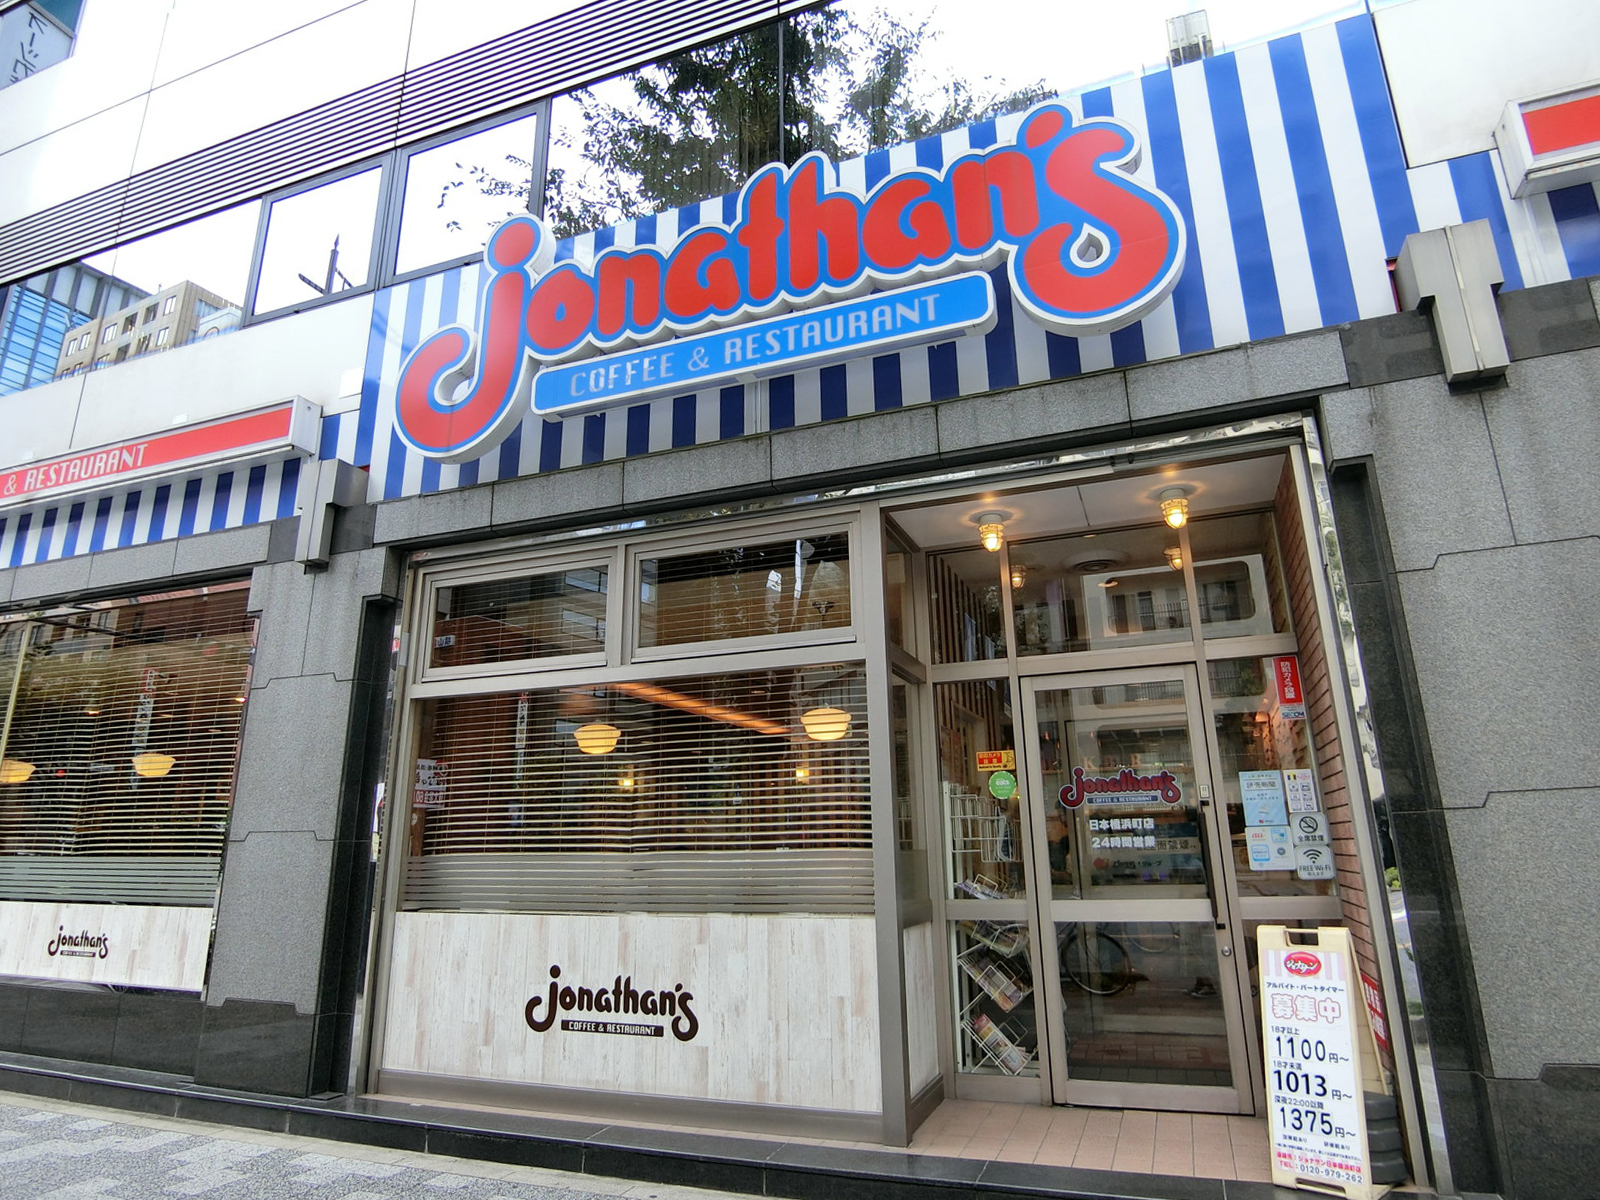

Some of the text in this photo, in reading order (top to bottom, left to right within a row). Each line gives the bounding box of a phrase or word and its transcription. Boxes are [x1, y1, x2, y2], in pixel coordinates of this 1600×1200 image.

[397, 107, 1175, 452] jonathan's
[570, 293, 940, 397] COFFEE & RESTAURANT
[3, 443, 149, 495] & RESTAURANT
[1060, 767, 1181, 808] jonathan's
[1089, 818, 1154, 830] 日本橋浜町店
[1092, 836, 1155, 849] 24時間営業
[48, 925, 108, 959] jonathan's
[525, 965, 698, 1041] jonathan's
[1271, 993, 1341, 1024] 募集中
[569, 1021, 656, 1035] COFFEE & RESTAURANT
[1271, 1026, 1300, 1035] 18才以上
[1273, 1060, 1302, 1071] 18才未満
